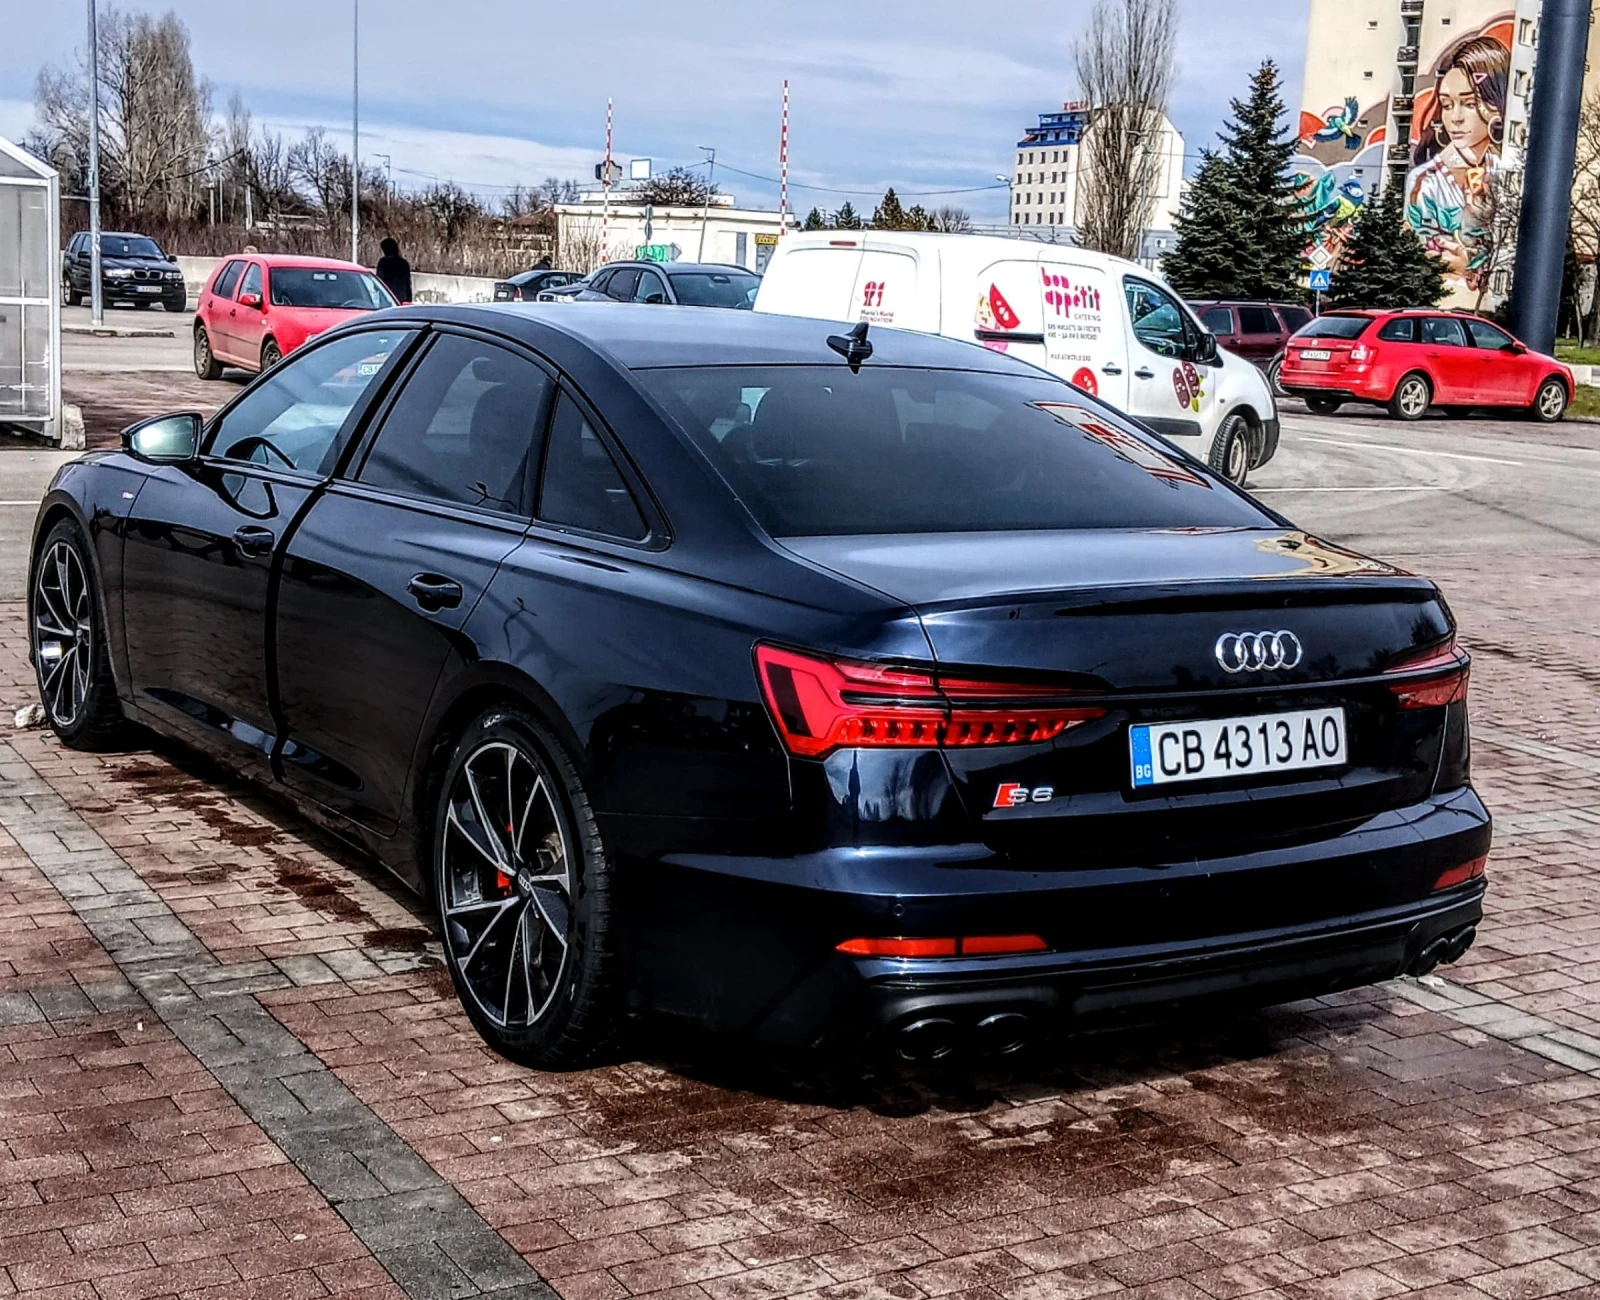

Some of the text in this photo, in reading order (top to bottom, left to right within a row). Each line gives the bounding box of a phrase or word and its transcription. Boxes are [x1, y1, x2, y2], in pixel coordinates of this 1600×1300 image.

[1041, 266, 1069, 289] bon
[1045, 285, 1101, 318] appétit
[1073, 313, 1101, 322] CATERING
[1158, 715, 1340, 777] CB 4313 AO
[1135, 764, 1151, 779] BG
[1005, 786, 1054, 804] S6
